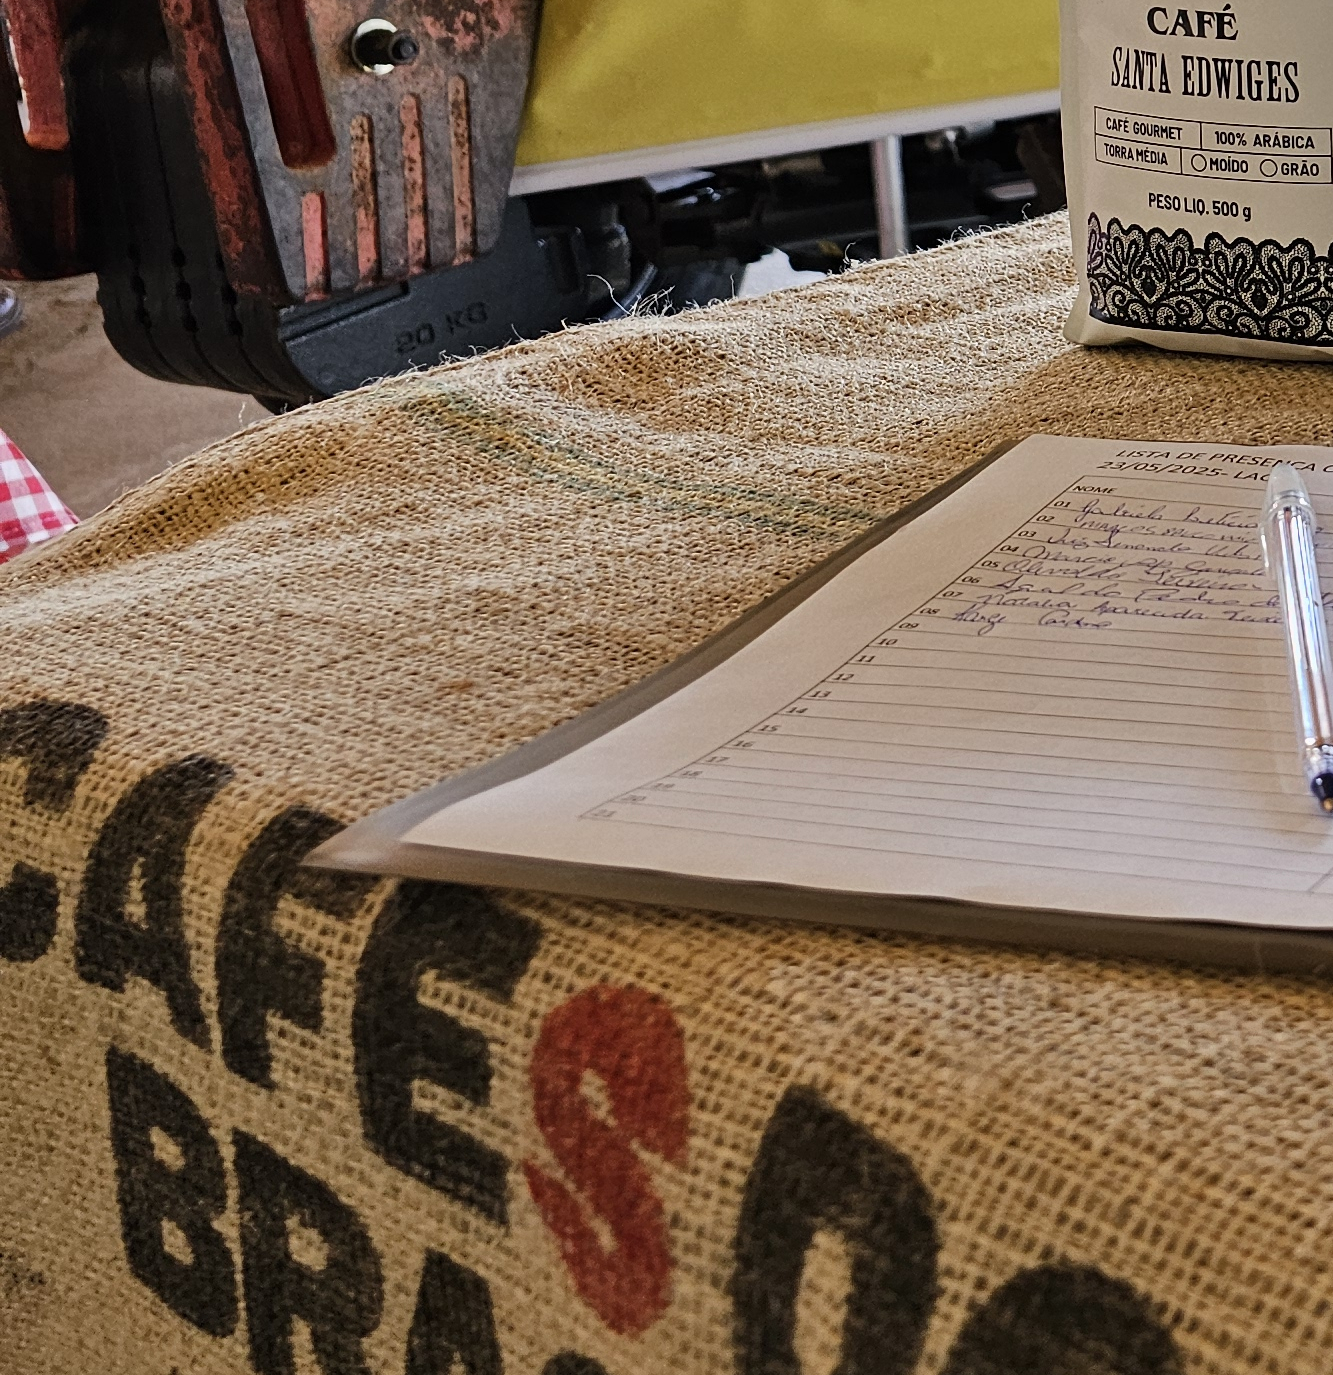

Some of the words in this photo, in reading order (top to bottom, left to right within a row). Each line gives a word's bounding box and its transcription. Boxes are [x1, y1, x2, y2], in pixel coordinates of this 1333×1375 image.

[1147, 3, 1239, 41] CAFÉ
[1111, 46, 1171, 94] SANTA
[1181, 54, 1300, 103] EDWIGES
[1106, 116, 1130, 134] CAFÉ
[1133, 121, 1183, 141] GOURMET
[1214, 131, 1248, 146] 100%
[1253, 131, 1315, 150] ARÁBICA
[1104, 142, 1134, 161] TORRA
[1136, 147, 1168, 166] MÉDIA
[1209, 156, 1249, 174] MOÍDO
[1281, 160, 1320, 177] GRÃO
[1148, 192, 1181, 212] PESO
[1184, 197, 1209, 216] LIQ.
[1212, 200, 1239, 218] 500
[1243, 206, 1252, 222] g
[1116, 449, 1171, 459] LISTA
[1175, 452, 1207, 461] DE
[1072, 485, 1116, 494] NOME
[1054, 501, 1071, 509] 01
[1036, 515, 1053, 523] 02
[1018, 530, 1037, 538] 03
[1000, 545, 1019, 553] 04
[981, 560, 1000, 568] 05
[962, 576, 980, 584] 06
